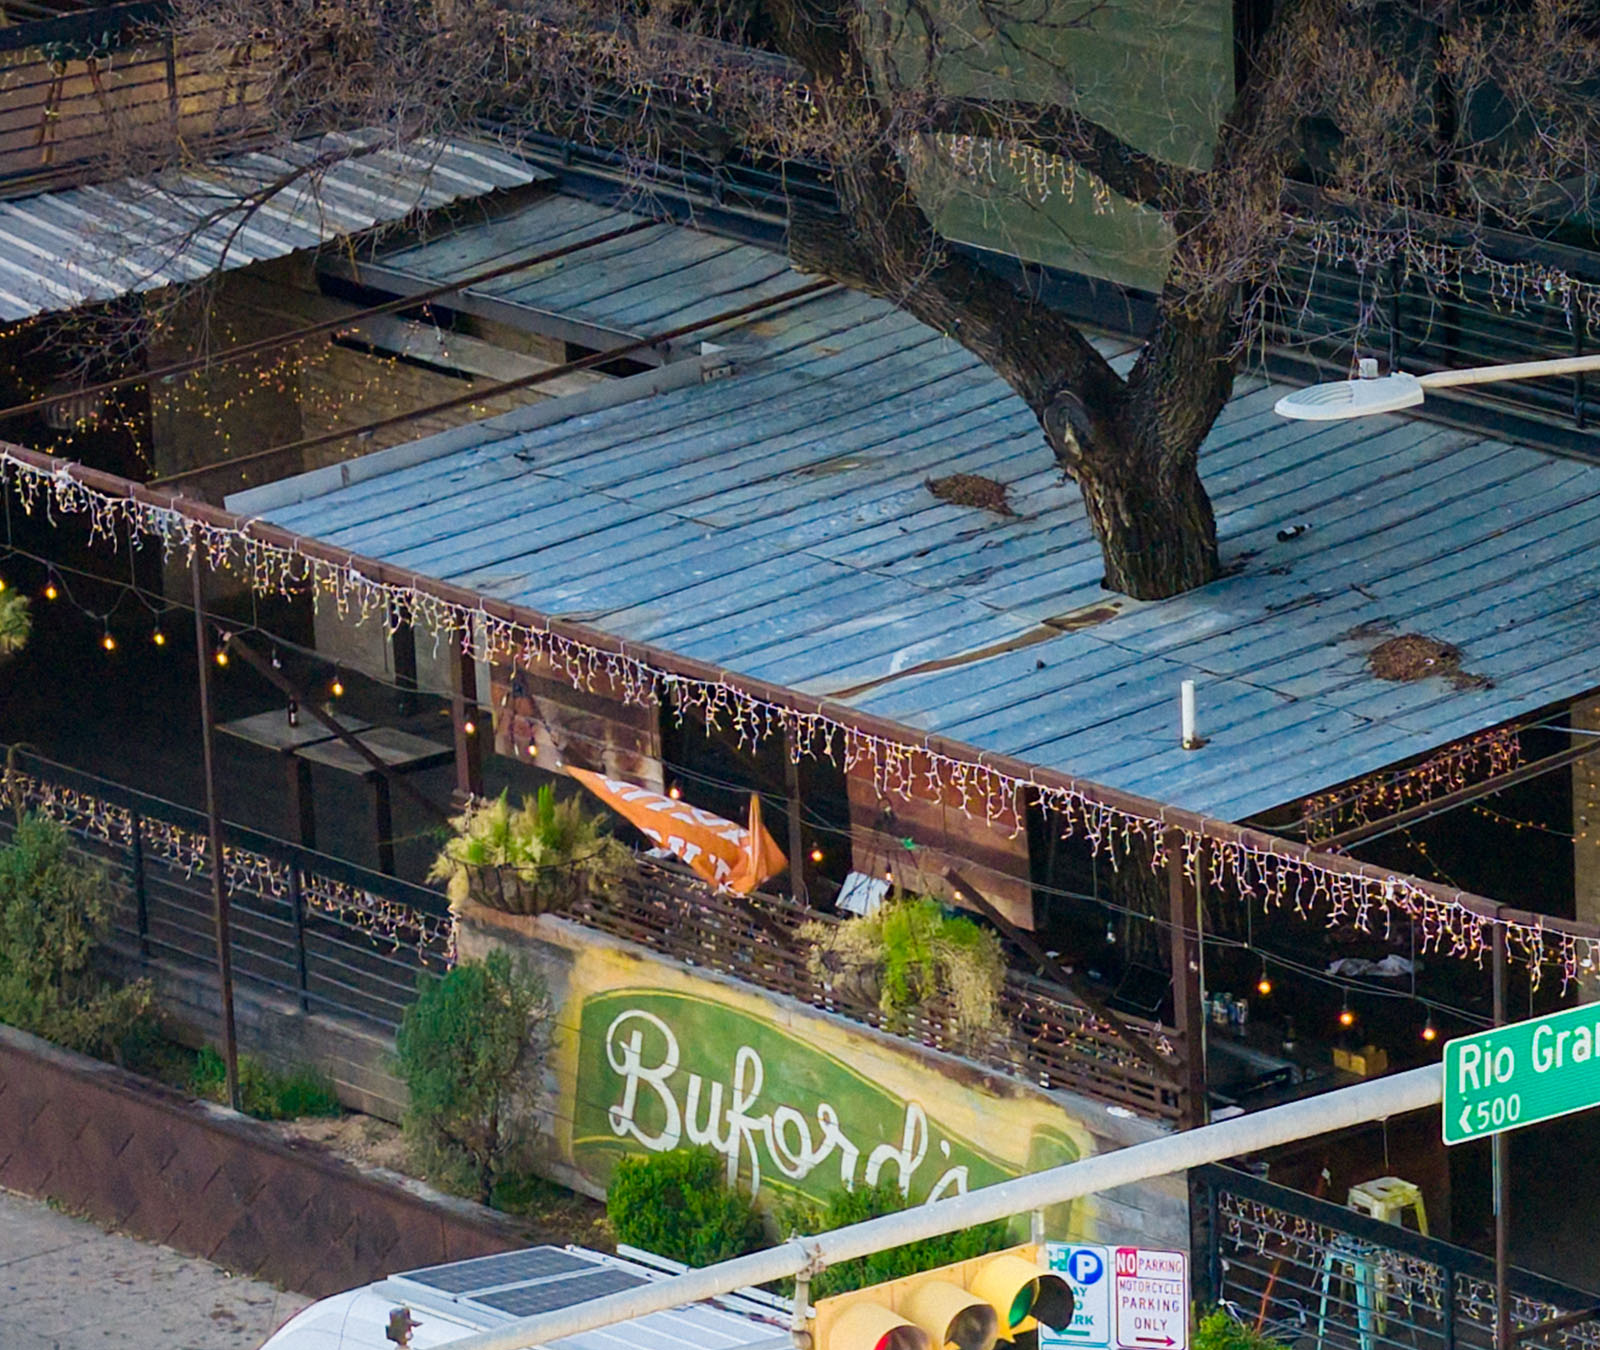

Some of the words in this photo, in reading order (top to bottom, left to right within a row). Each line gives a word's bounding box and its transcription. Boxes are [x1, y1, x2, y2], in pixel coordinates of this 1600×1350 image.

[1458, 1040, 1515, 1094] Rio
[1476, 1093, 1521, 1130] 500
[1117, 1252, 1137, 1274] NO
[1139, 1257, 1182, 1274] PARKING
[1120, 1280, 1182, 1295] MOTORCYCLE
[1122, 1296, 1180, 1312] PARKING
[1134, 1317, 1168, 1332] ONLY
